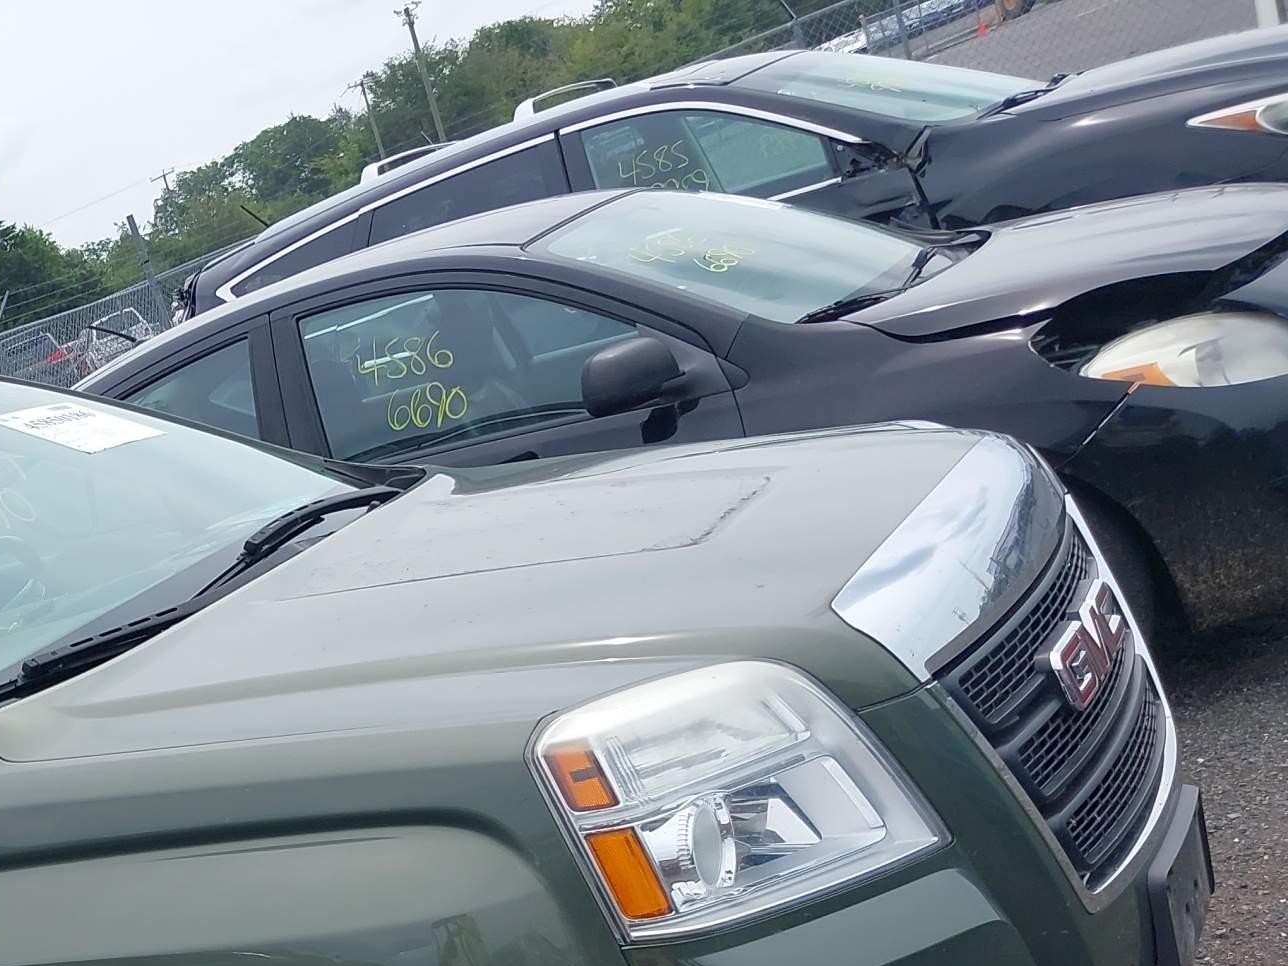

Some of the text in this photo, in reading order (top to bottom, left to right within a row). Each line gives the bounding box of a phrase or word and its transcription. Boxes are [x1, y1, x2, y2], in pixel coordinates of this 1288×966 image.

[618, 140, 689, 185] 4585
[356, 329, 454, 386] 4586
[387, 381, 468, 431] 6690
[1049, 578, 1127, 711] GMC
